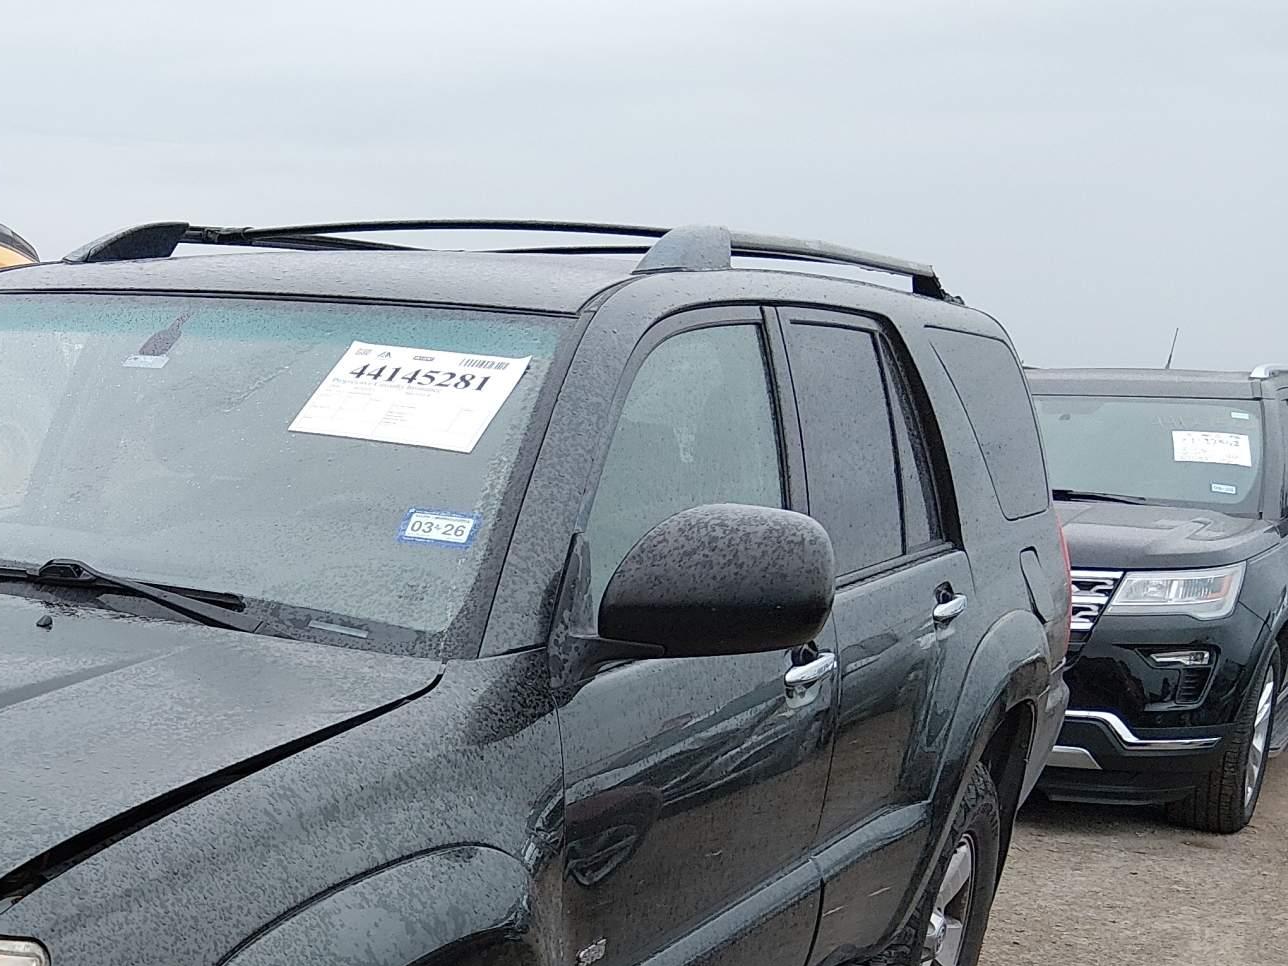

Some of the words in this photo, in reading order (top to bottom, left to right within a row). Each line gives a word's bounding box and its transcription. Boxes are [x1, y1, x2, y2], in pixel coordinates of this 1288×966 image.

[349, 363, 493, 392] 44145281
[410, 520, 434, 534] 03
[441, 523, 467, 537] 26
